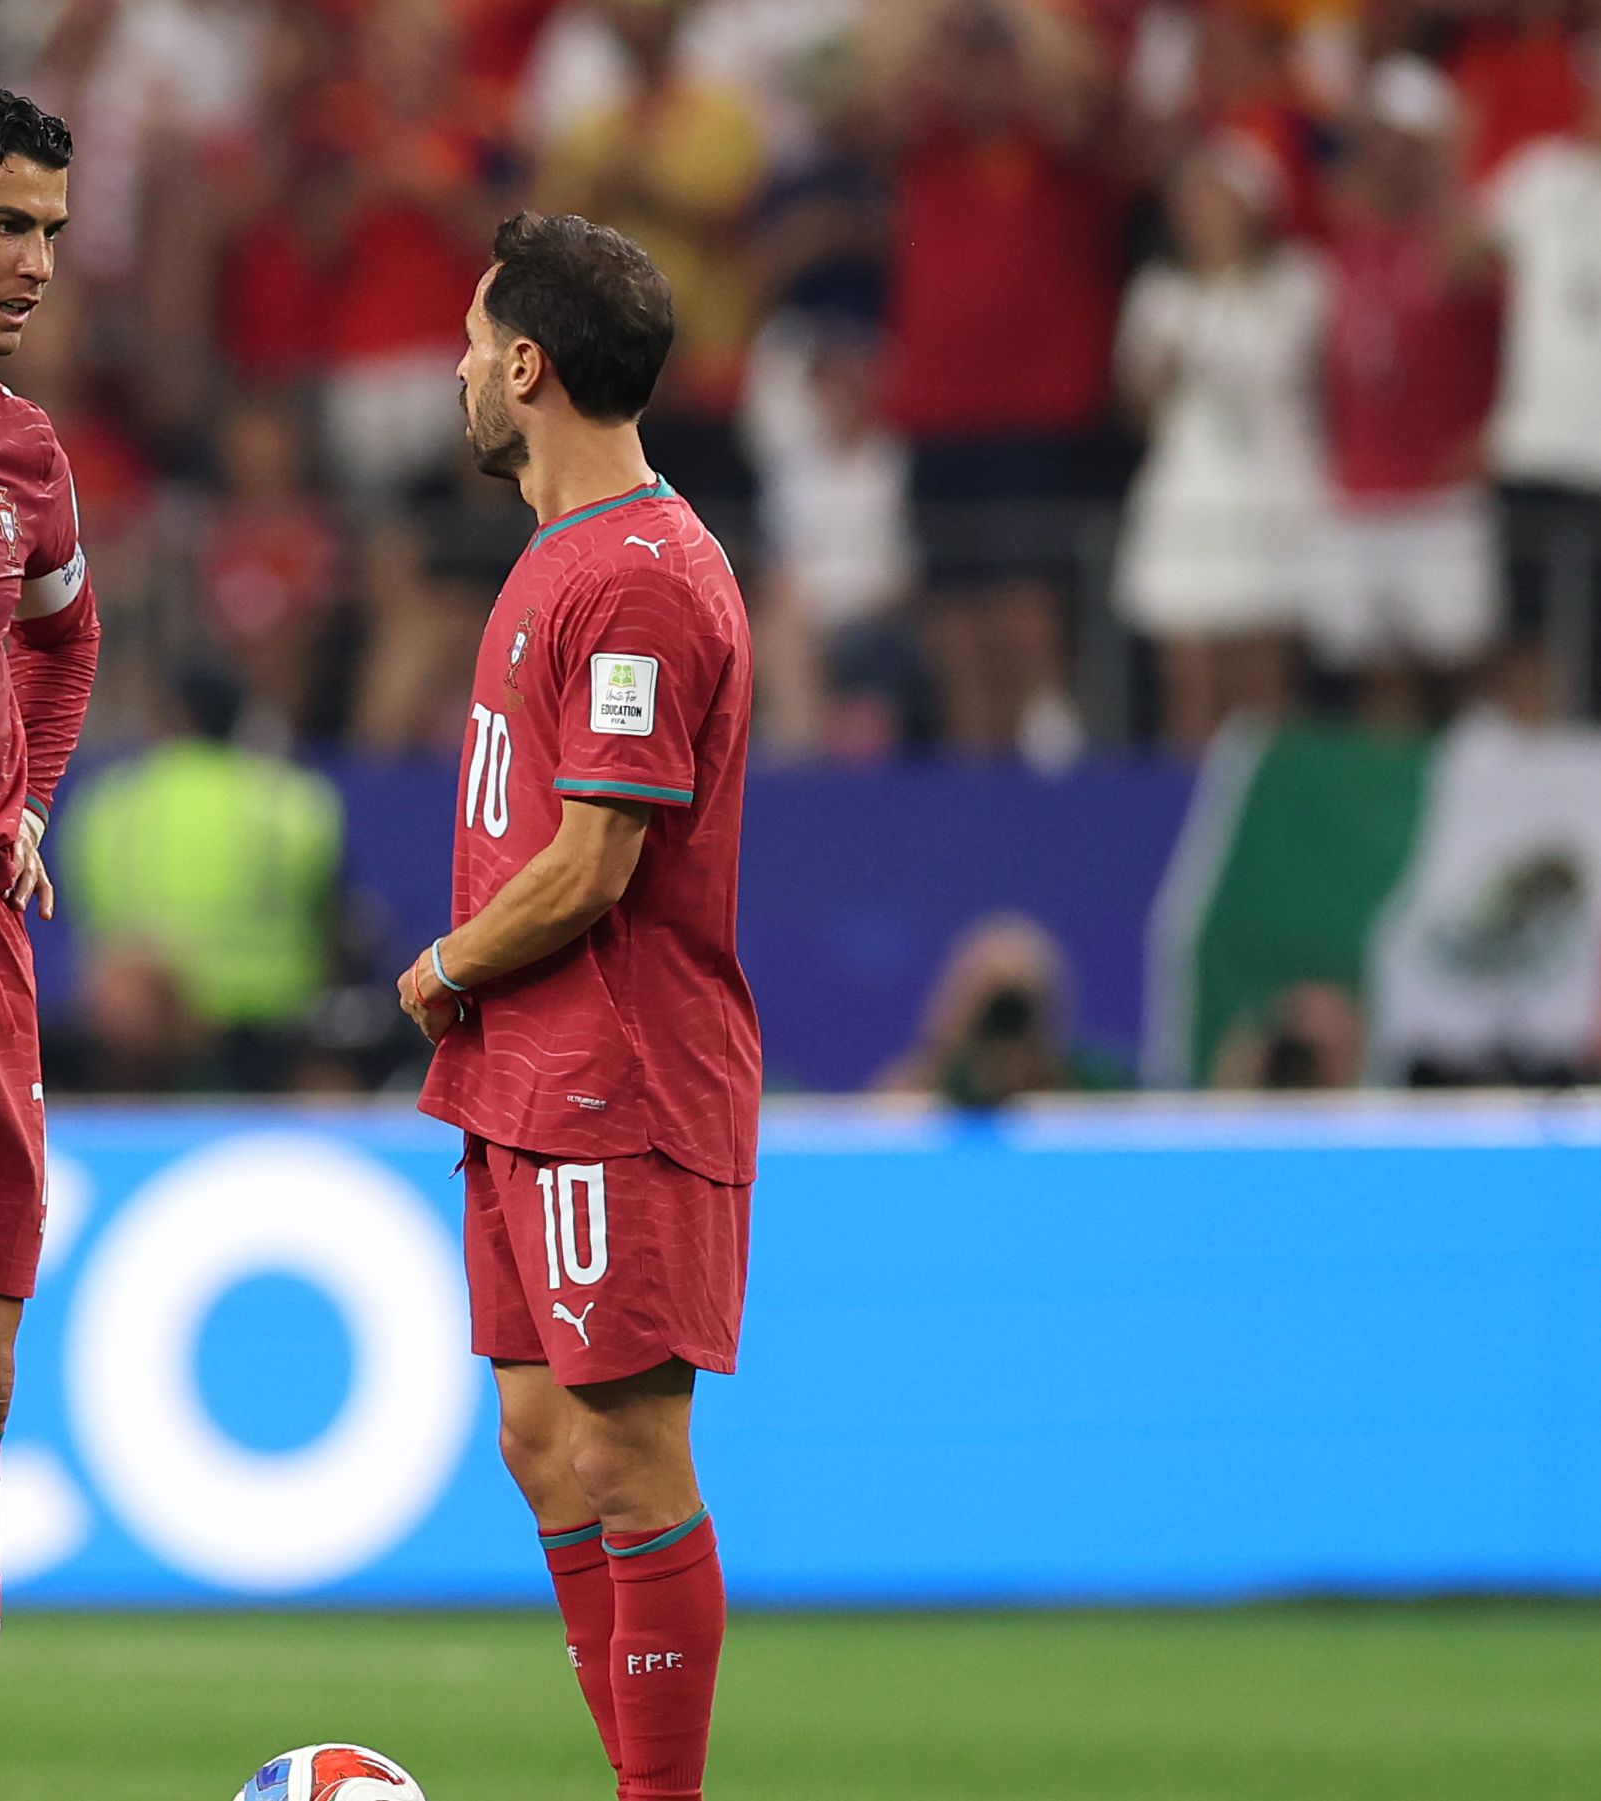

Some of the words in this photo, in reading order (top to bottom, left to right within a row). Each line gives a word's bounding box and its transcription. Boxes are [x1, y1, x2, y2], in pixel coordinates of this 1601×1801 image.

[465, 702, 512, 838] 10
[601, 704, 642, 717] EDUCATION
[536, 1163, 608, 1289] 10
